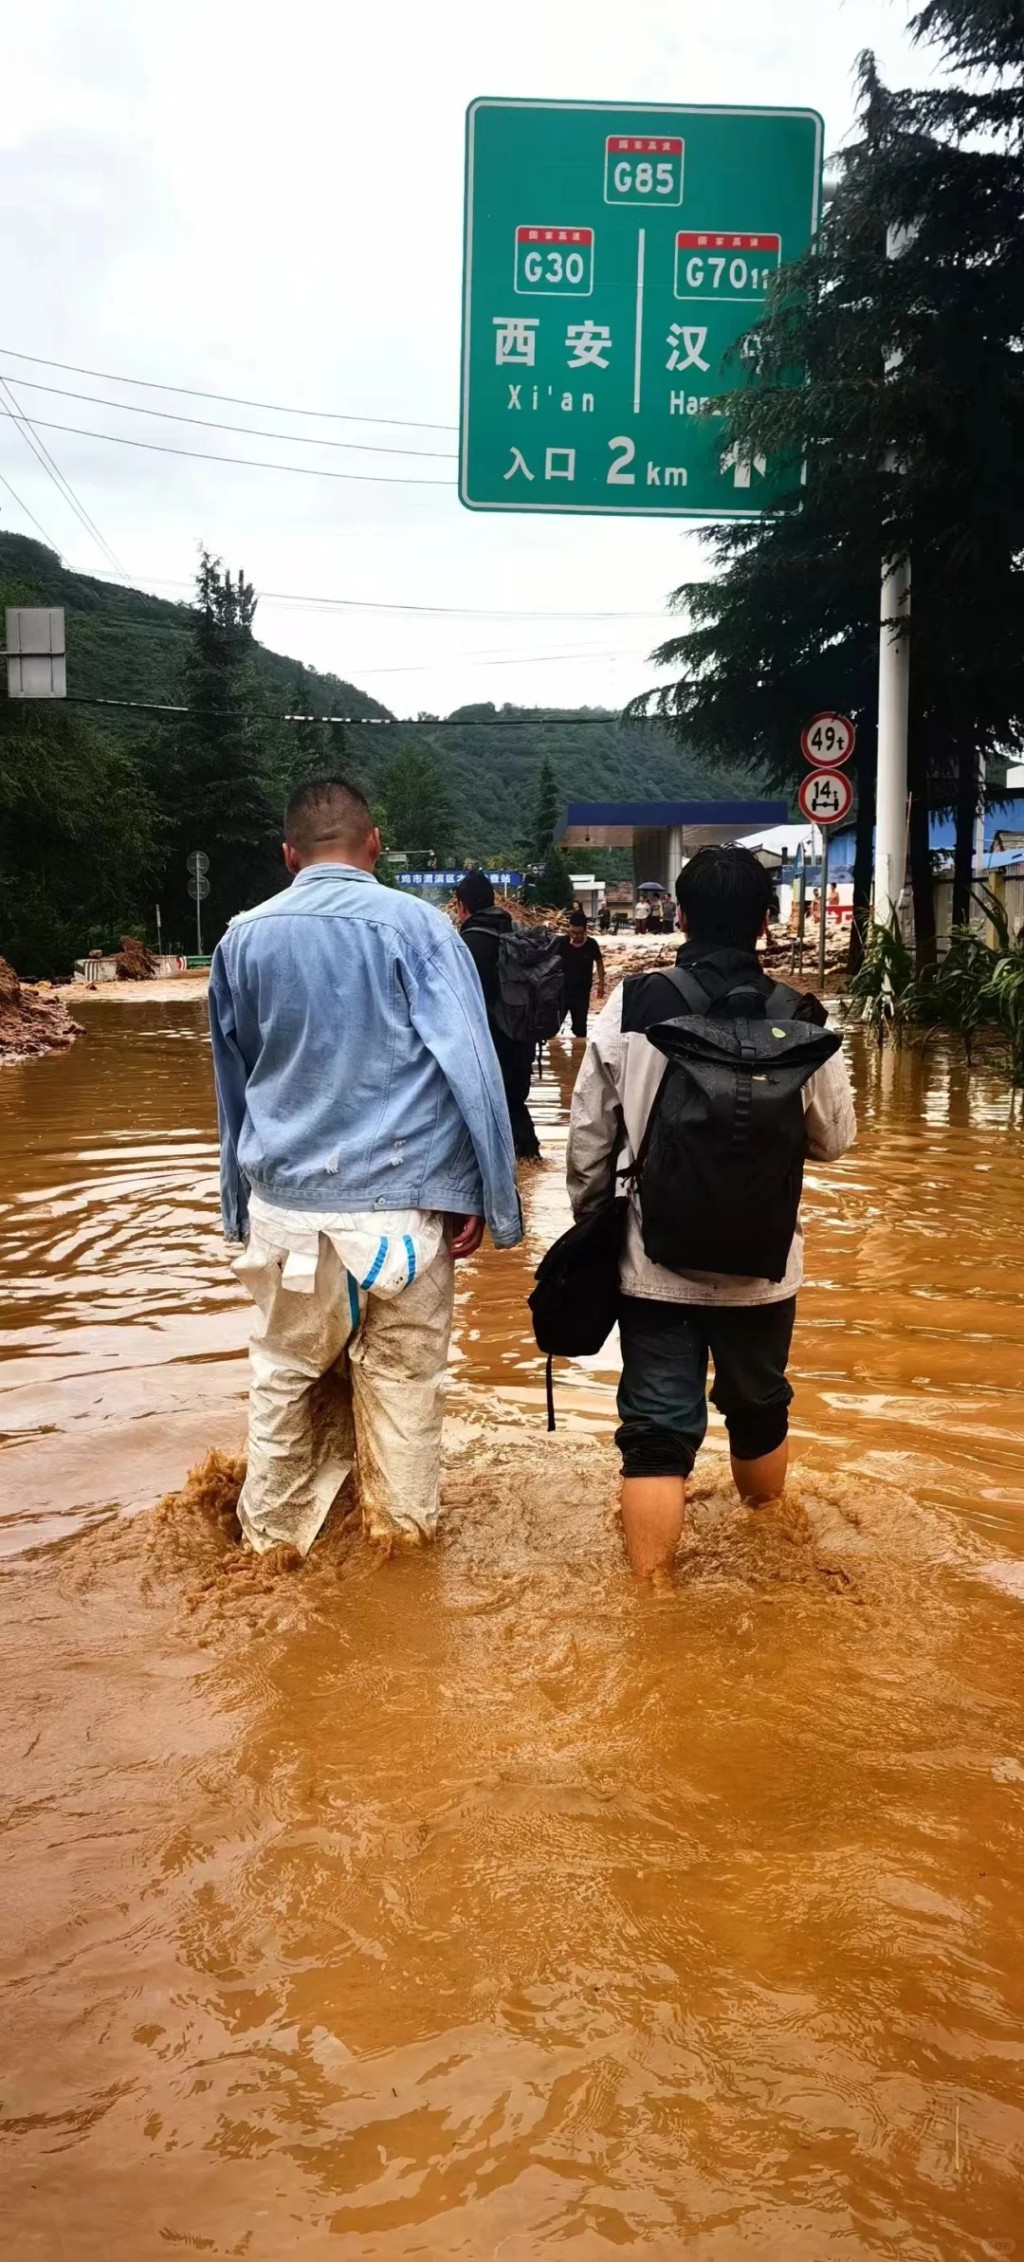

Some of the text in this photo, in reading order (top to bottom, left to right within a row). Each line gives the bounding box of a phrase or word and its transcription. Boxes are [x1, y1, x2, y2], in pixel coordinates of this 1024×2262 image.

[614, 161, 674, 194] G85
[524, 251, 584, 284] G30
[492, 316, 612, 369] 西安
[507, 384, 595, 413] Xi'an
[503, 435, 688, 487] 入口 2 km
[811, 726, 845, 752] 49t
[814, 780, 838, 799] 14t
